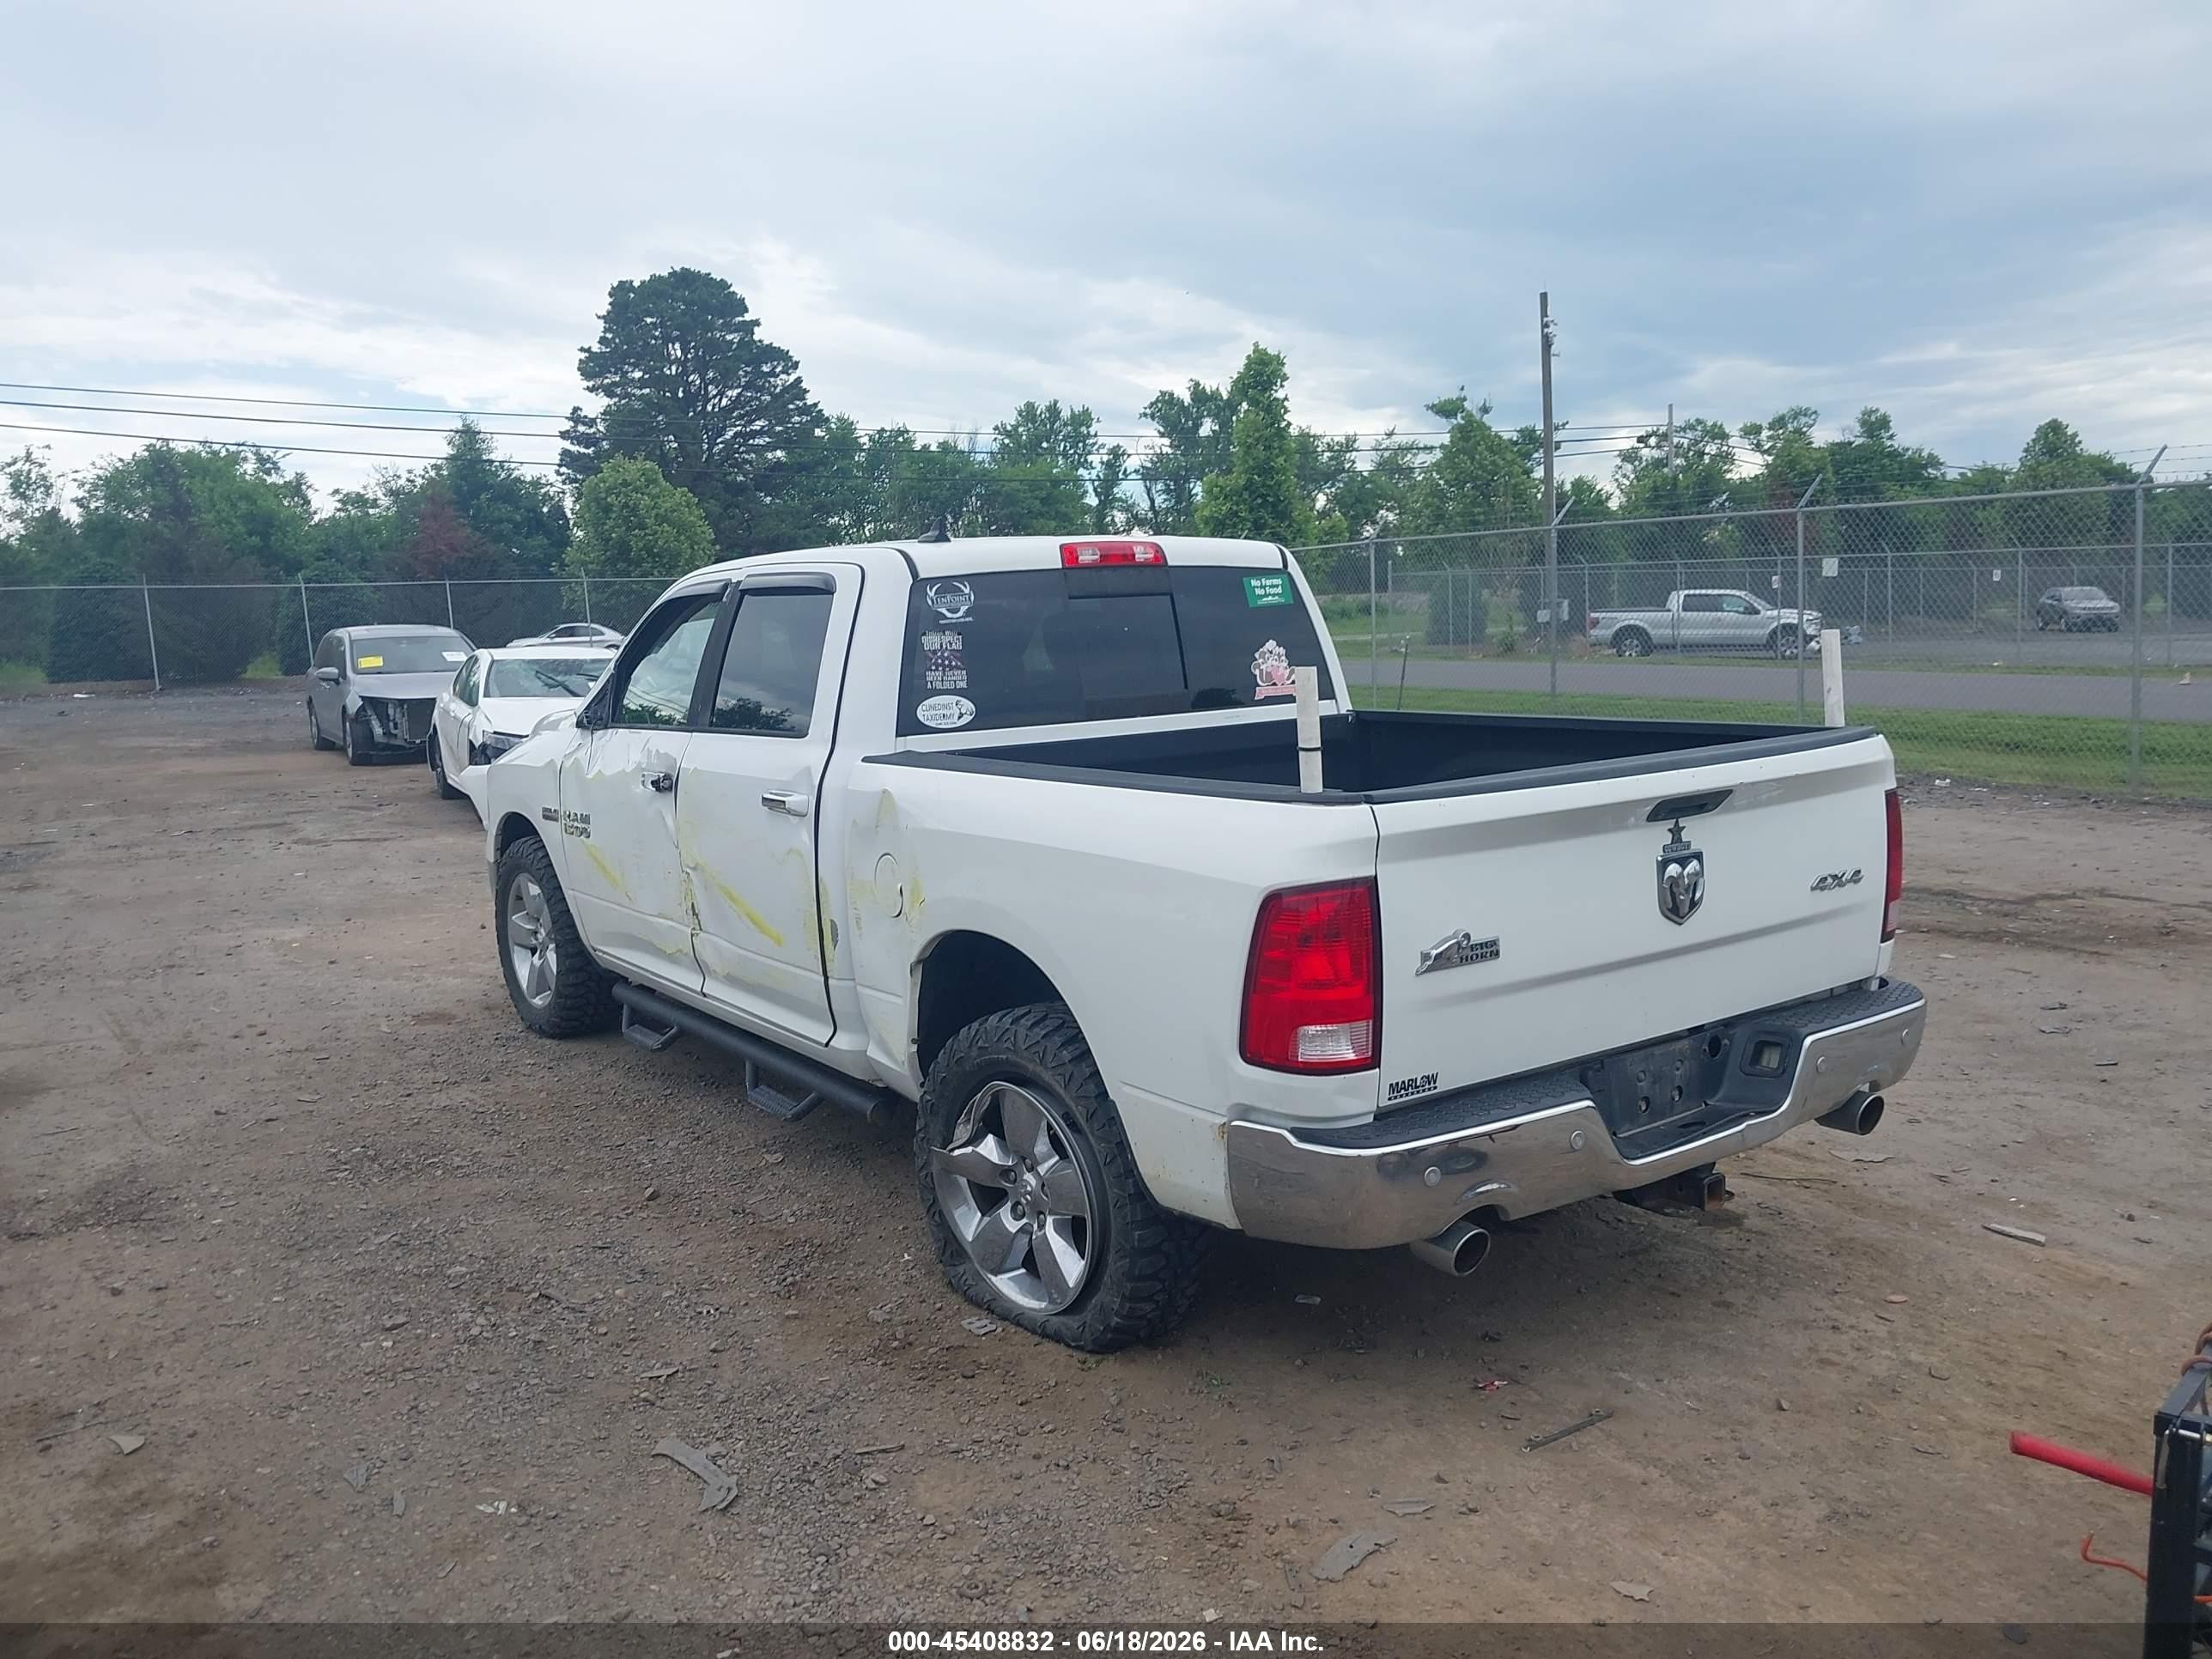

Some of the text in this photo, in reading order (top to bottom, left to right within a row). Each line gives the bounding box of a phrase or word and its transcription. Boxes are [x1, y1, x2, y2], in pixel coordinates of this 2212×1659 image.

[1250, 577, 1283, 587] No Farms
[1255, 584, 1283, 596] No Food
[933, 680, 955, 690] FOLDED
[956, 680, 969, 689] ONE
[922, 712, 956, 722] TAXIDERMY
[1469, 939, 1498, 952] BIG
[1459, 948, 1499, 963] HORN
[1388, 1071, 1439, 1097] MARLOW
